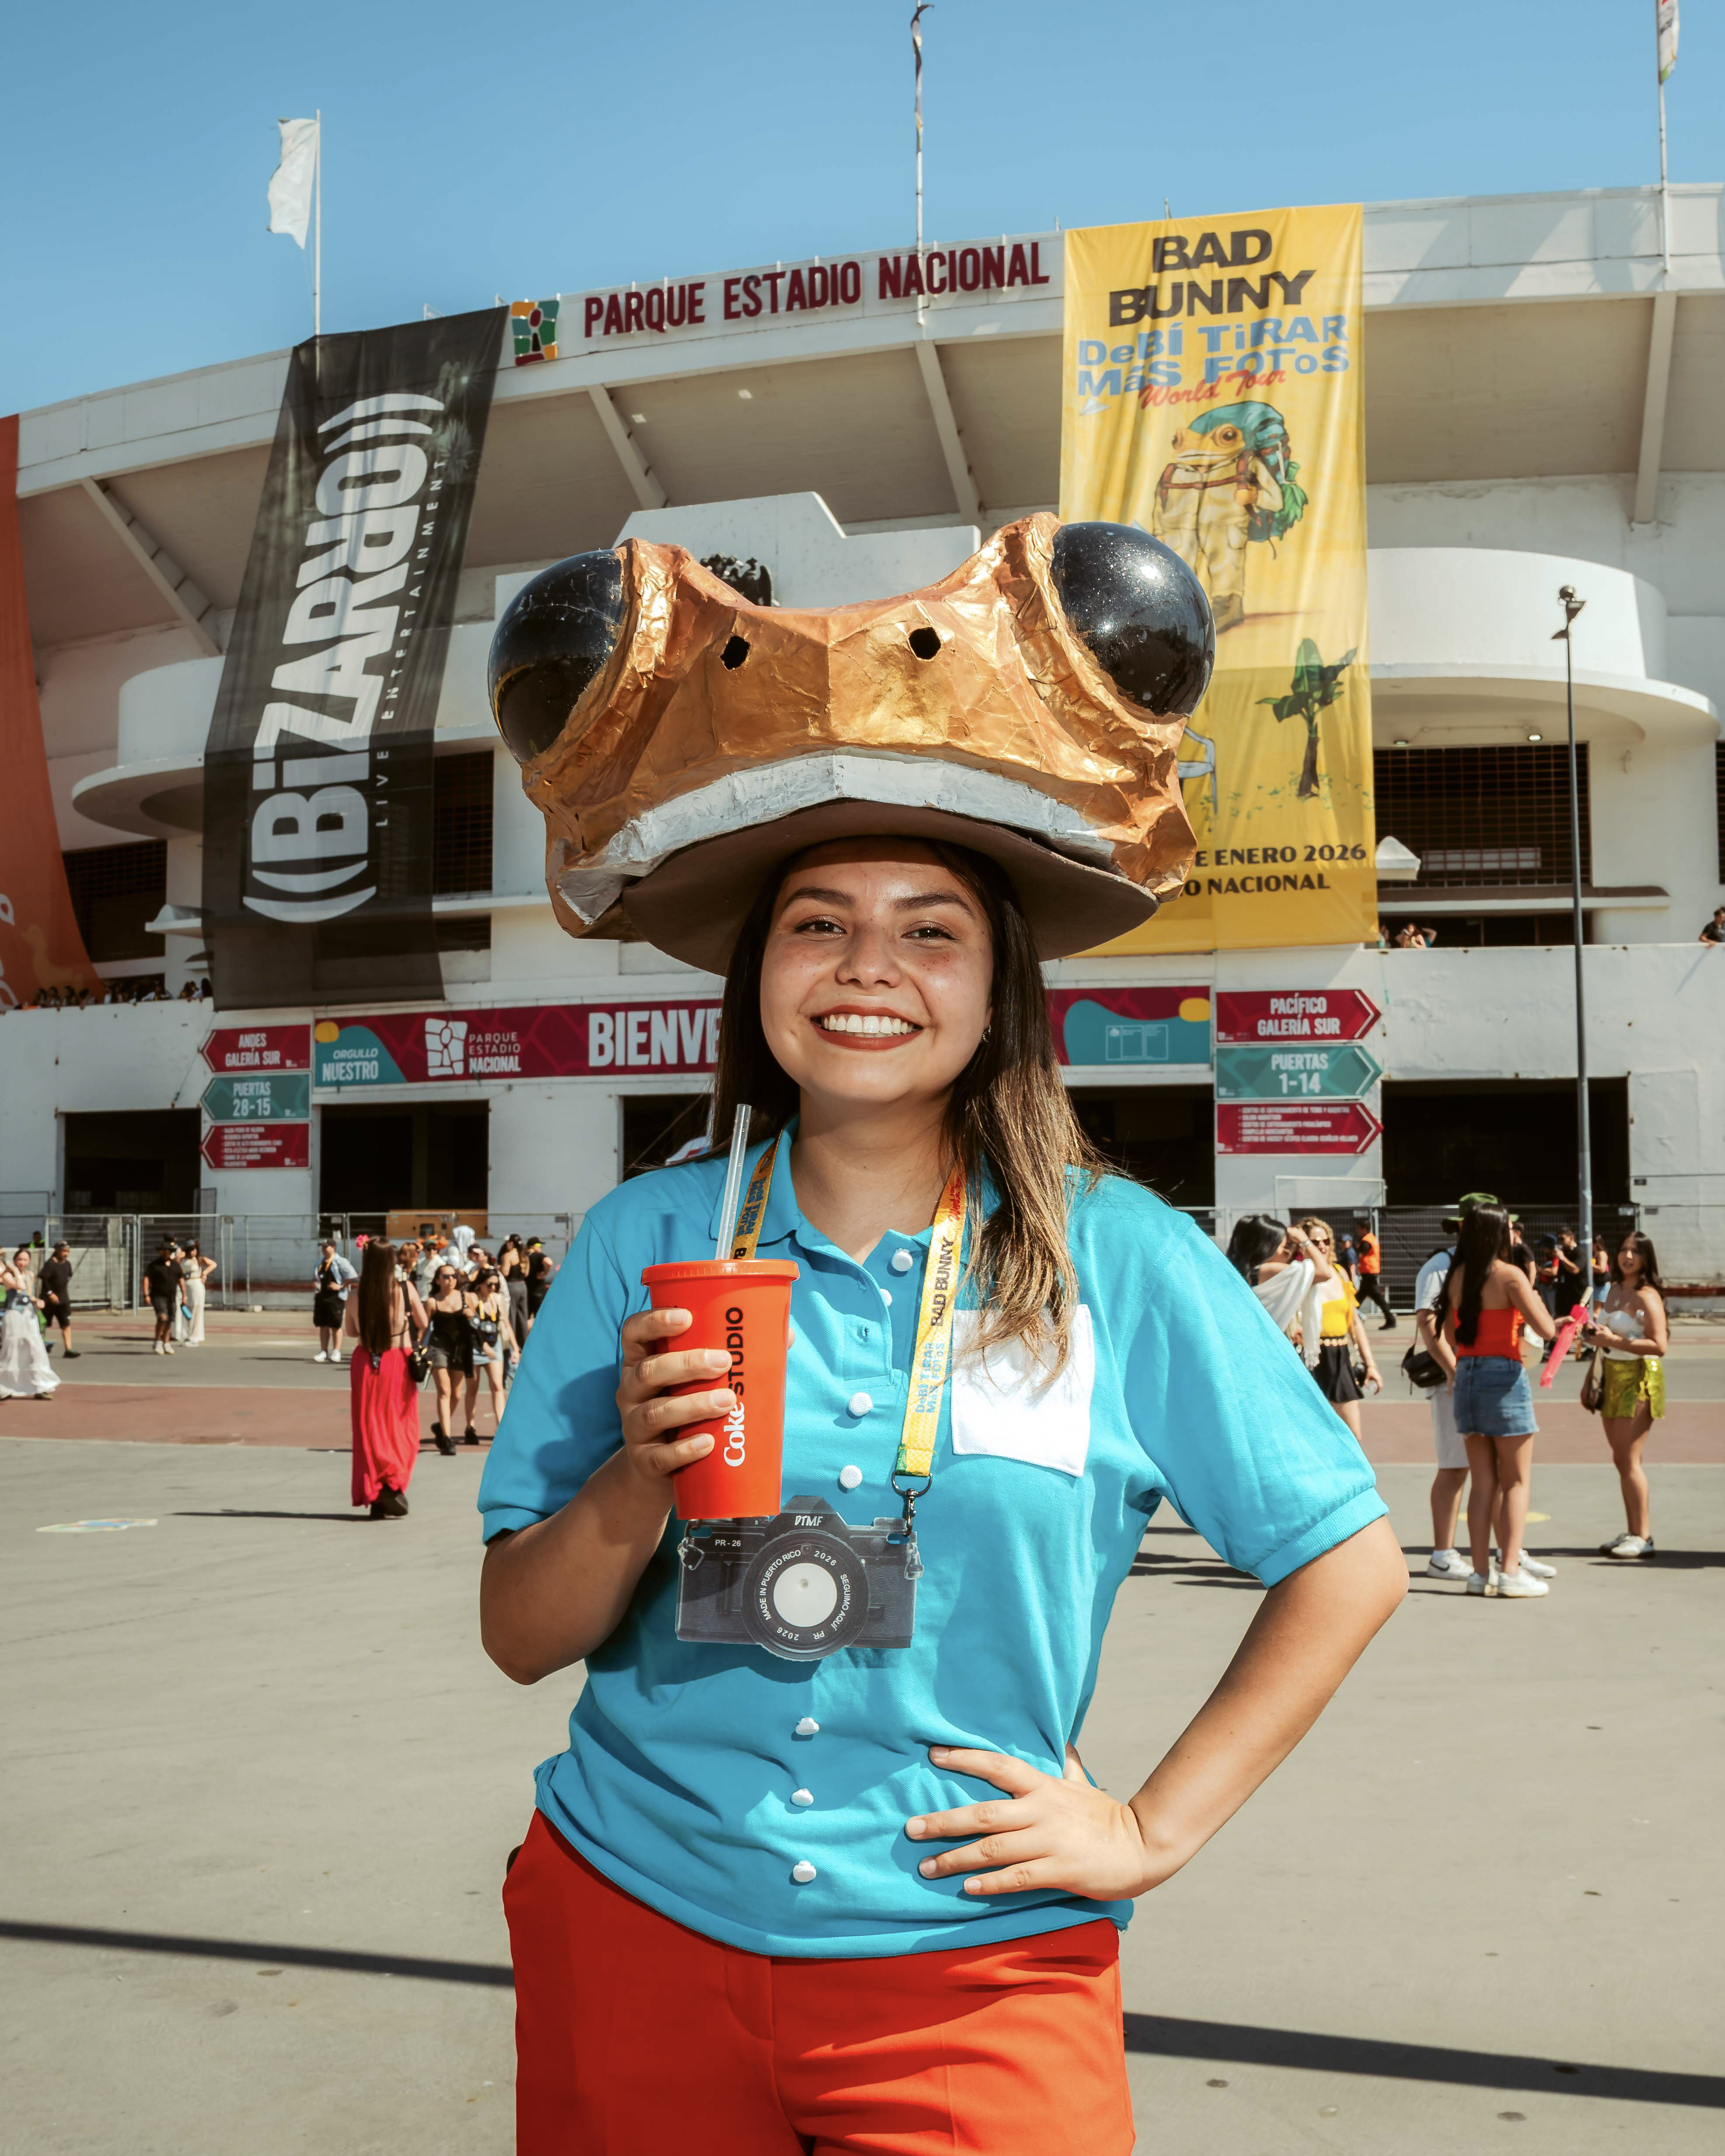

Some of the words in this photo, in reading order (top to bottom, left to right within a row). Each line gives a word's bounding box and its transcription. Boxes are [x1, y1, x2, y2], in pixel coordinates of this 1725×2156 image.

[1152, 229, 1272, 273] BAD
[584, 282, 705, 338] PARQUE
[723, 261, 861, 321] ESTADIO
[878, 241, 1050, 300] NACIONAL
[1109, 270, 1316, 327] BUNNY
[1138, 375, 1220, 409] World
[1225, 370, 1286, 396] Tour
[382, 459, 446, 720] ENTERTAINMENT
[376, 749, 389, 827] LIVE
[1195, 851, 1208, 866] E
[1215, 846, 1296, 865] ENERO
[1304, 844, 1366, 862] 2026
[1208, 873, 1330, 895] NACIONAL
[1270, 992, 1327, 1015] PACÍFICO
[1257, 1015, 1310, 1036] GALERÍA
[1314, 1018, 1340, 1035] SUR
[239, 1033, 266, 1048] ANDES
[469, 1032, 518, 1043] PARQUE
[226, 1048, 259, 1067] GALERÍA
[263, 1051, 280, 1064] SUR
[333, 1048, 378, 1060] ORGULLO
[469, 1043, 520, 1055] ESTADIO
[322, 1061, 378, 1082] NUESTRO
[469, 1056, 521, 1074] NACIONAL
[1271, 1054, 1329, 1071] PUERTAS
[233, 1081, 271, 1097] PUERTAS
[1279, 1072, 1321, 1094] 1-14
[233, 1098, 271, 1116] 28-15
[935, 1236, 953, 1291] BUNNY
[930, 1294, 946, 1326] BAD
[723, 1402, 745, 1467] Coke
[794, 1515, 823, 1526] DTMF
[782, 1550, 801, 1561] RICO
[814, 1551, 837, 1566] 2026
[761, 1559, 782, 1586] PUERTO
[840, 1574, 850, 1610] SEGUIMO
[759, 1598, 772, 1620] MADE
[831, 1610, 845, 1631] AQUÍ
[777, 1627, 799, 1641] 2026
[813, 1630, 825, 1640] PR
